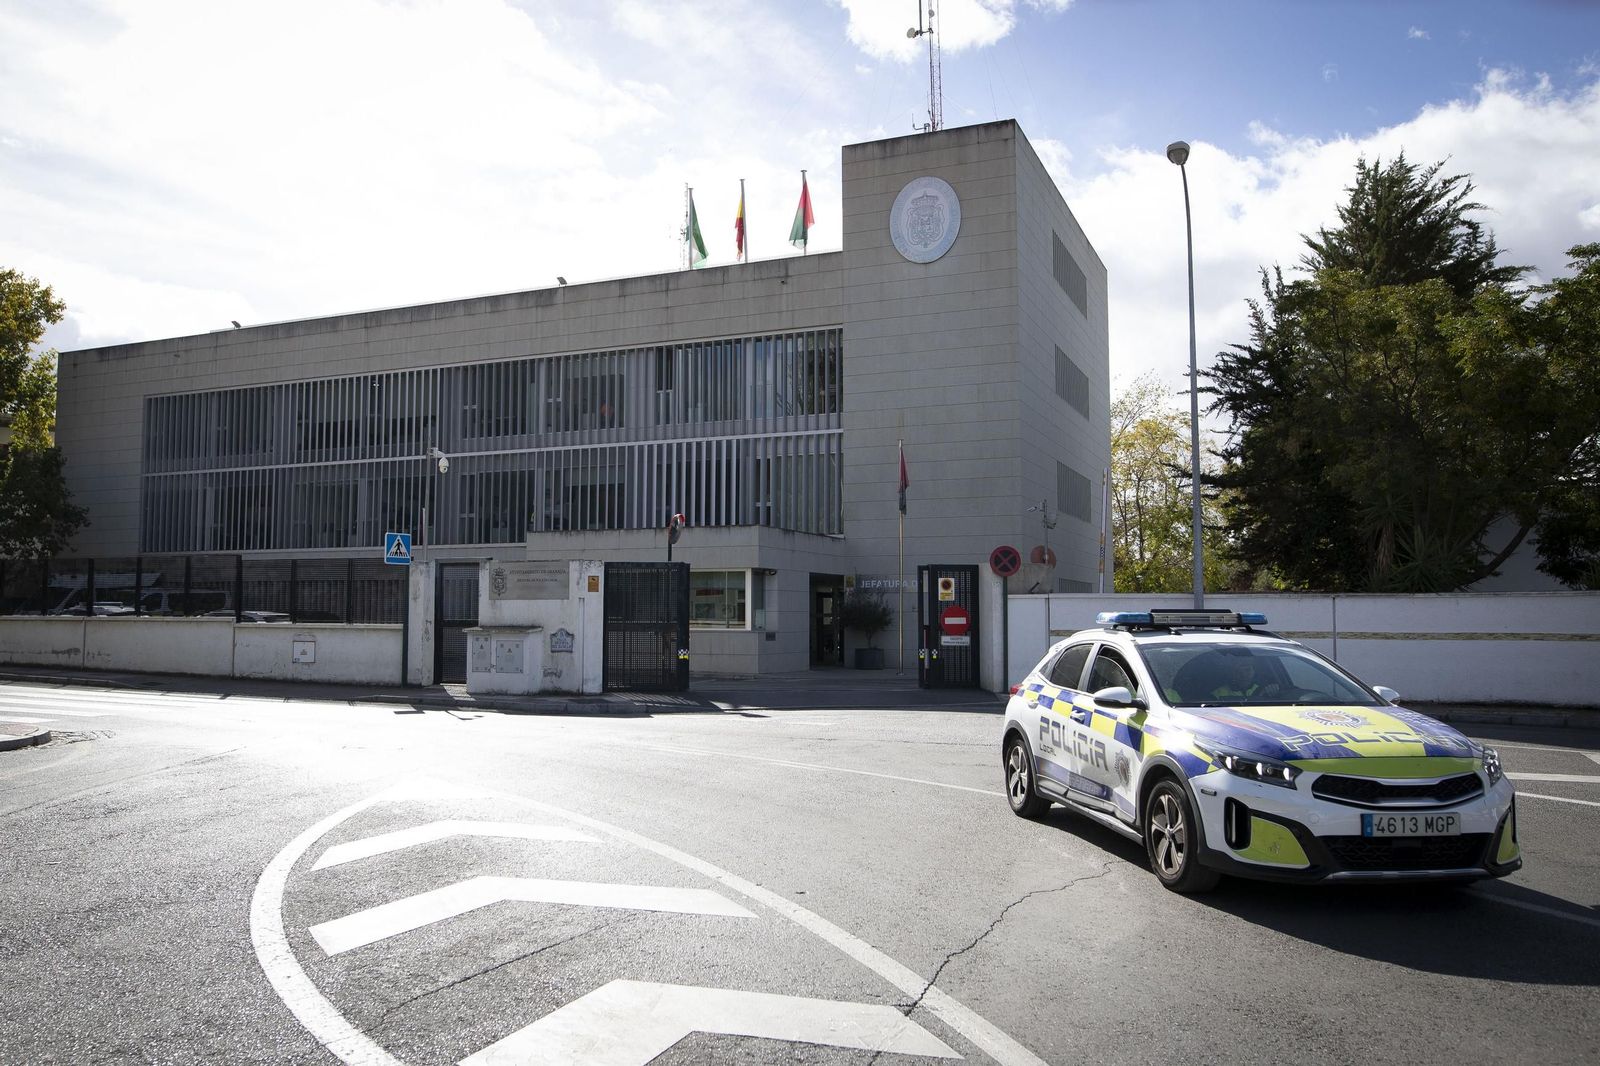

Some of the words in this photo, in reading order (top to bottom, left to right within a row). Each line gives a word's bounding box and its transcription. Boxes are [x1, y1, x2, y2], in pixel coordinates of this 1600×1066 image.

[861, 579, 909, 589] JEFATURA
[1375, 817, 1418, 834] 4613
[1424, 816, 1455, 833] MGP
